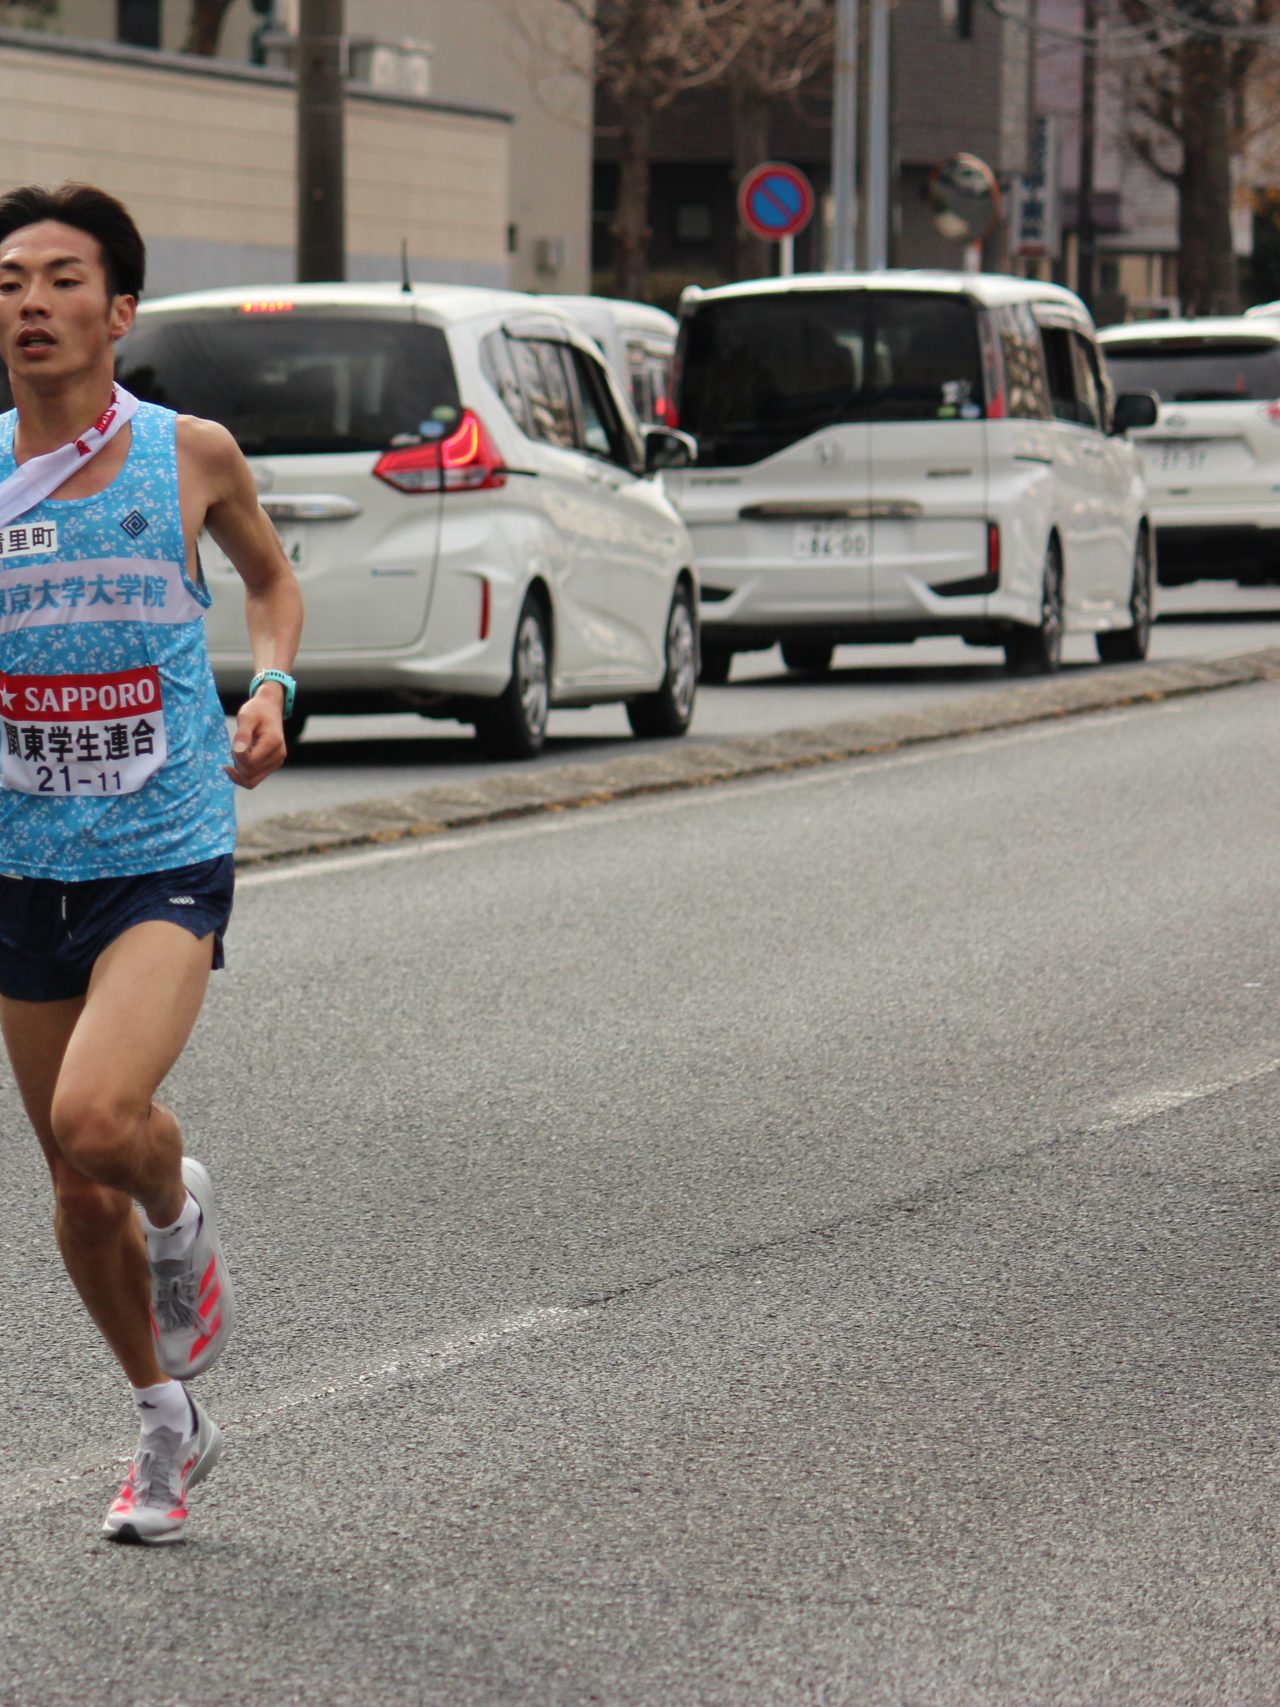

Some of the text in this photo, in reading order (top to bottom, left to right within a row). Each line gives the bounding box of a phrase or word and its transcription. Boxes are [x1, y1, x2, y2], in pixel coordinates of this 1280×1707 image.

[24, 678, 155, 712] SAPPORO
[4, 719, 155, 763] 関東学生連合
[36, 765, 121, 792] 21-11
